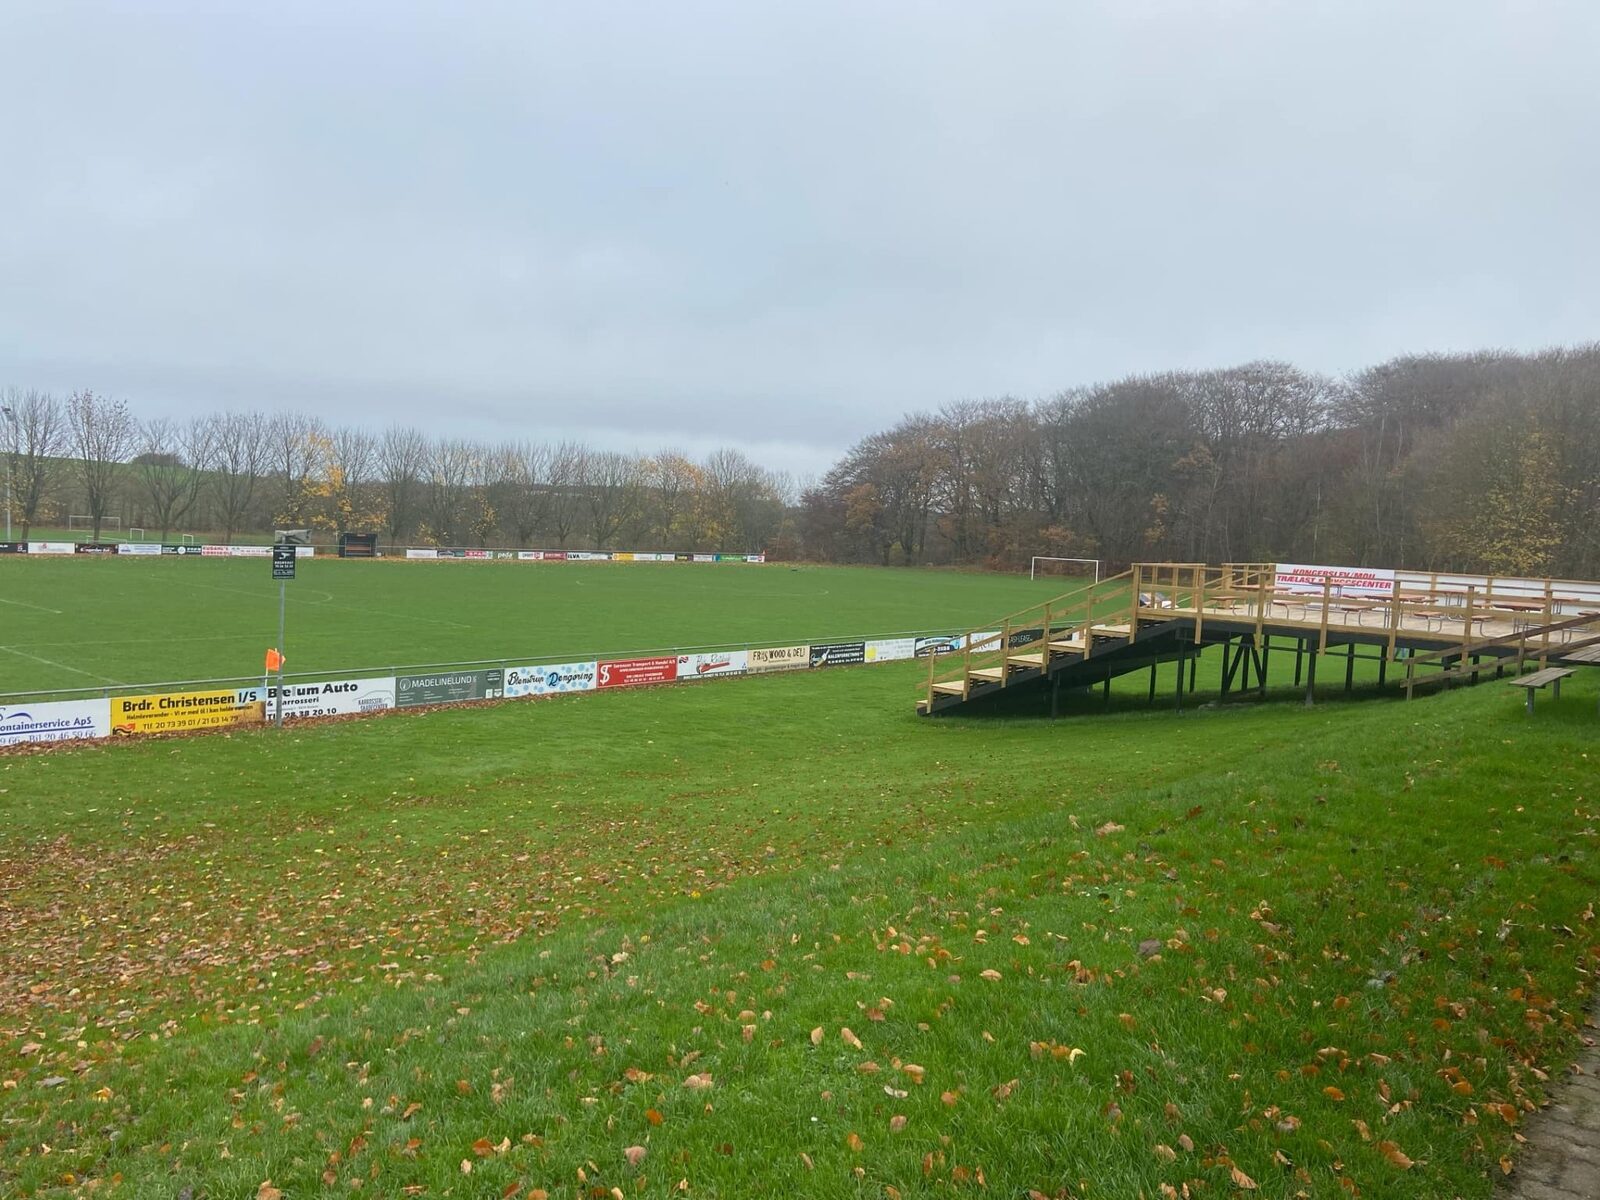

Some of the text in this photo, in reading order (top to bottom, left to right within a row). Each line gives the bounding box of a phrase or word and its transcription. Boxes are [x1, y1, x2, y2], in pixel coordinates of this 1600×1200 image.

[1276, 575, 1316, 584] TRÆLAST
[769, 649, 786, 659] WOOD
[793, 647, 805, 658] DELI
[322, 682, 359, 694] Auto
[411, 675, 472, 688] MADELINELUND
[123, 691, 257, 713] Brdr. Christensen I/S
[281, 697, 319, 706] arrosseri
[267, 713, 277, 721] Tl
[312, 708, 324, 716] 20
[327, 707, 337, 715] 10
[0, 716, 92, 732] ontainerservice ApS
[156, 721, 166, 729] 20
[167, 720, 176, 728] 73
[177, 719, 187, 727] 39
[202, 717, 210, 725] 21
[211, 716, 220, 724] 63
[221, 715, 229, 723] 14
